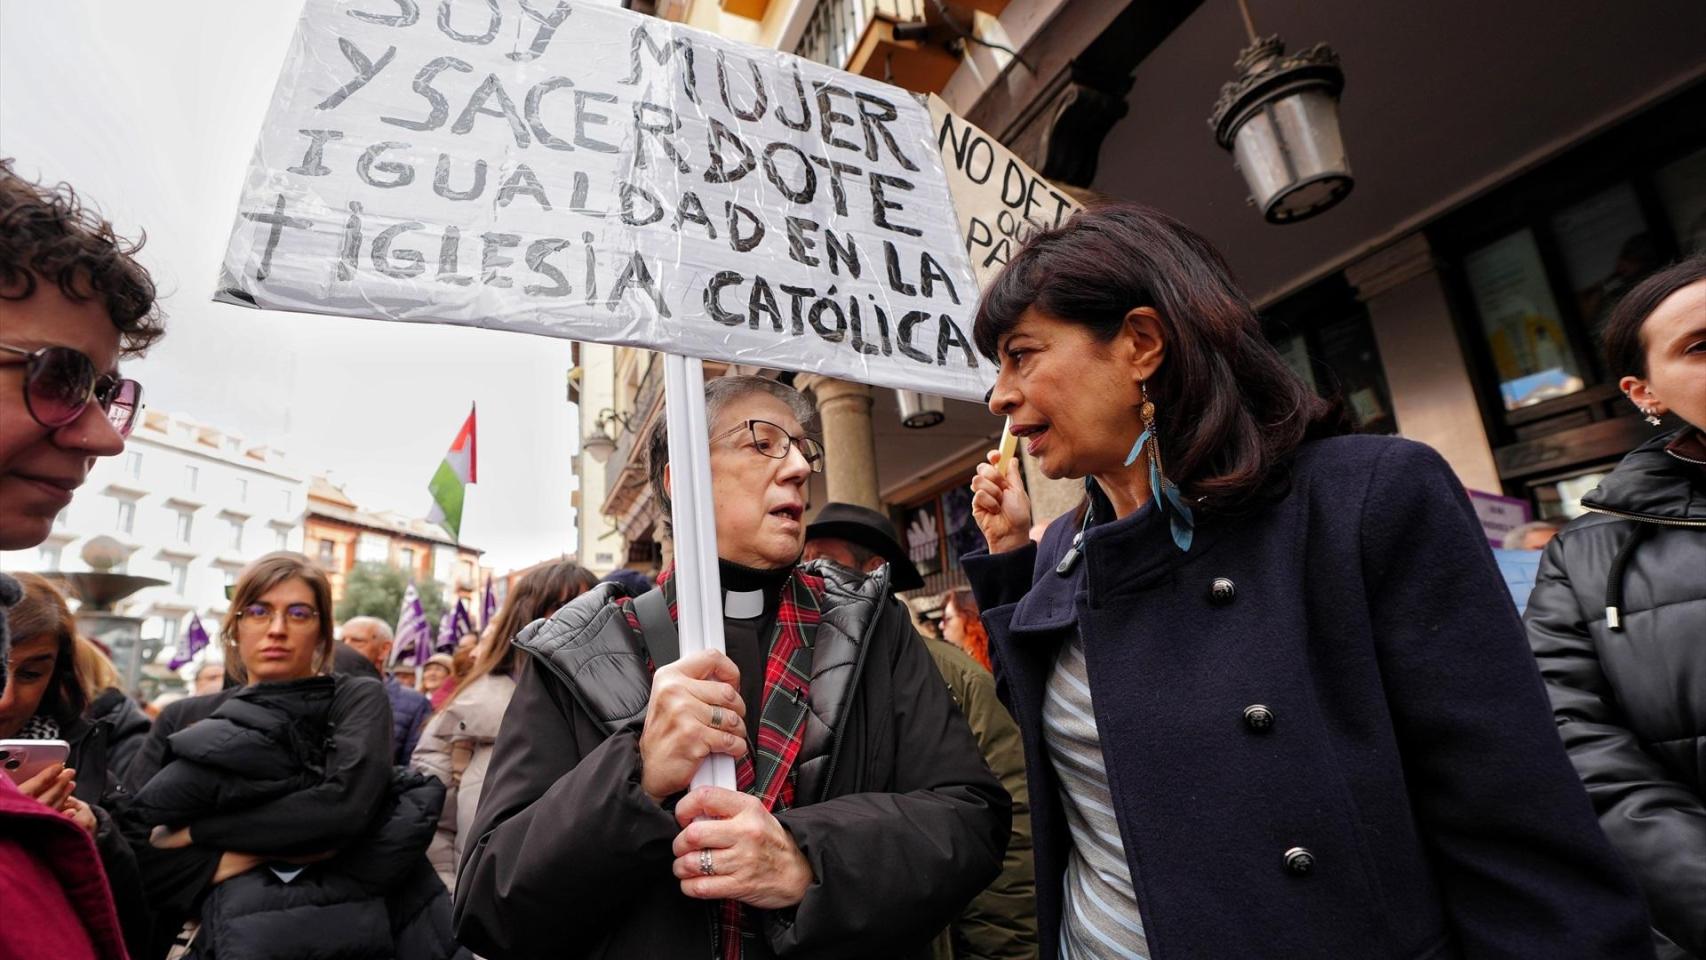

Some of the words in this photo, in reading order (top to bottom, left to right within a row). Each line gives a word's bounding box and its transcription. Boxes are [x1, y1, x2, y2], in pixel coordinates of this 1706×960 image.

[315, 36, 397, 110] Y
[380, 56, 923, 237] SACERDOTE
[617, 25, 920, 172] MUJER
[938, 113, 994, 185] NO
[1001, 158, 1083, 231] DET
[286, 129, 766, 252] IGUALDAD
[785, 216, 861, 279] EN
[883, 240, 961, 305] LA
